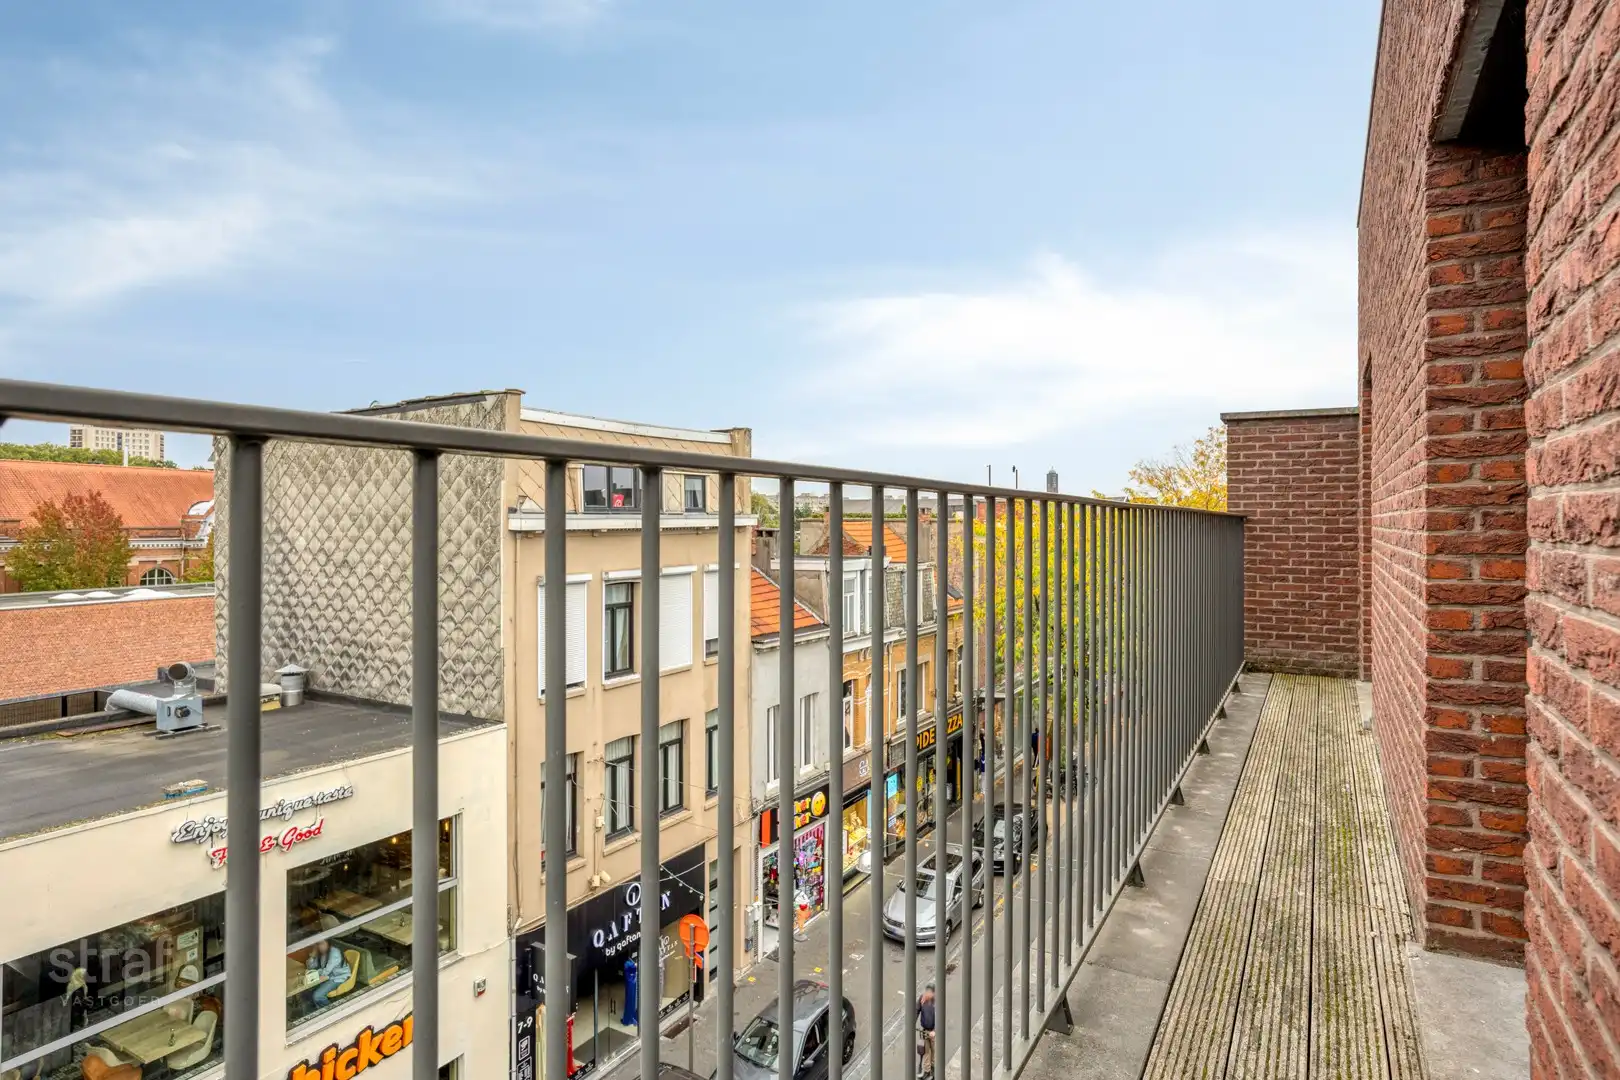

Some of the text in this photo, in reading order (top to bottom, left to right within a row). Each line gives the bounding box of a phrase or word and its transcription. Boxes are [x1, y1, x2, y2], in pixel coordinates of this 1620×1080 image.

[315, 785, 354, 805] taste
[280, 818, 324, 852] Good
[592, 890, 671, 948] QAFTN
[605, 947, 616, 956] by
[517, 1016, 533, 1034] 7-9
